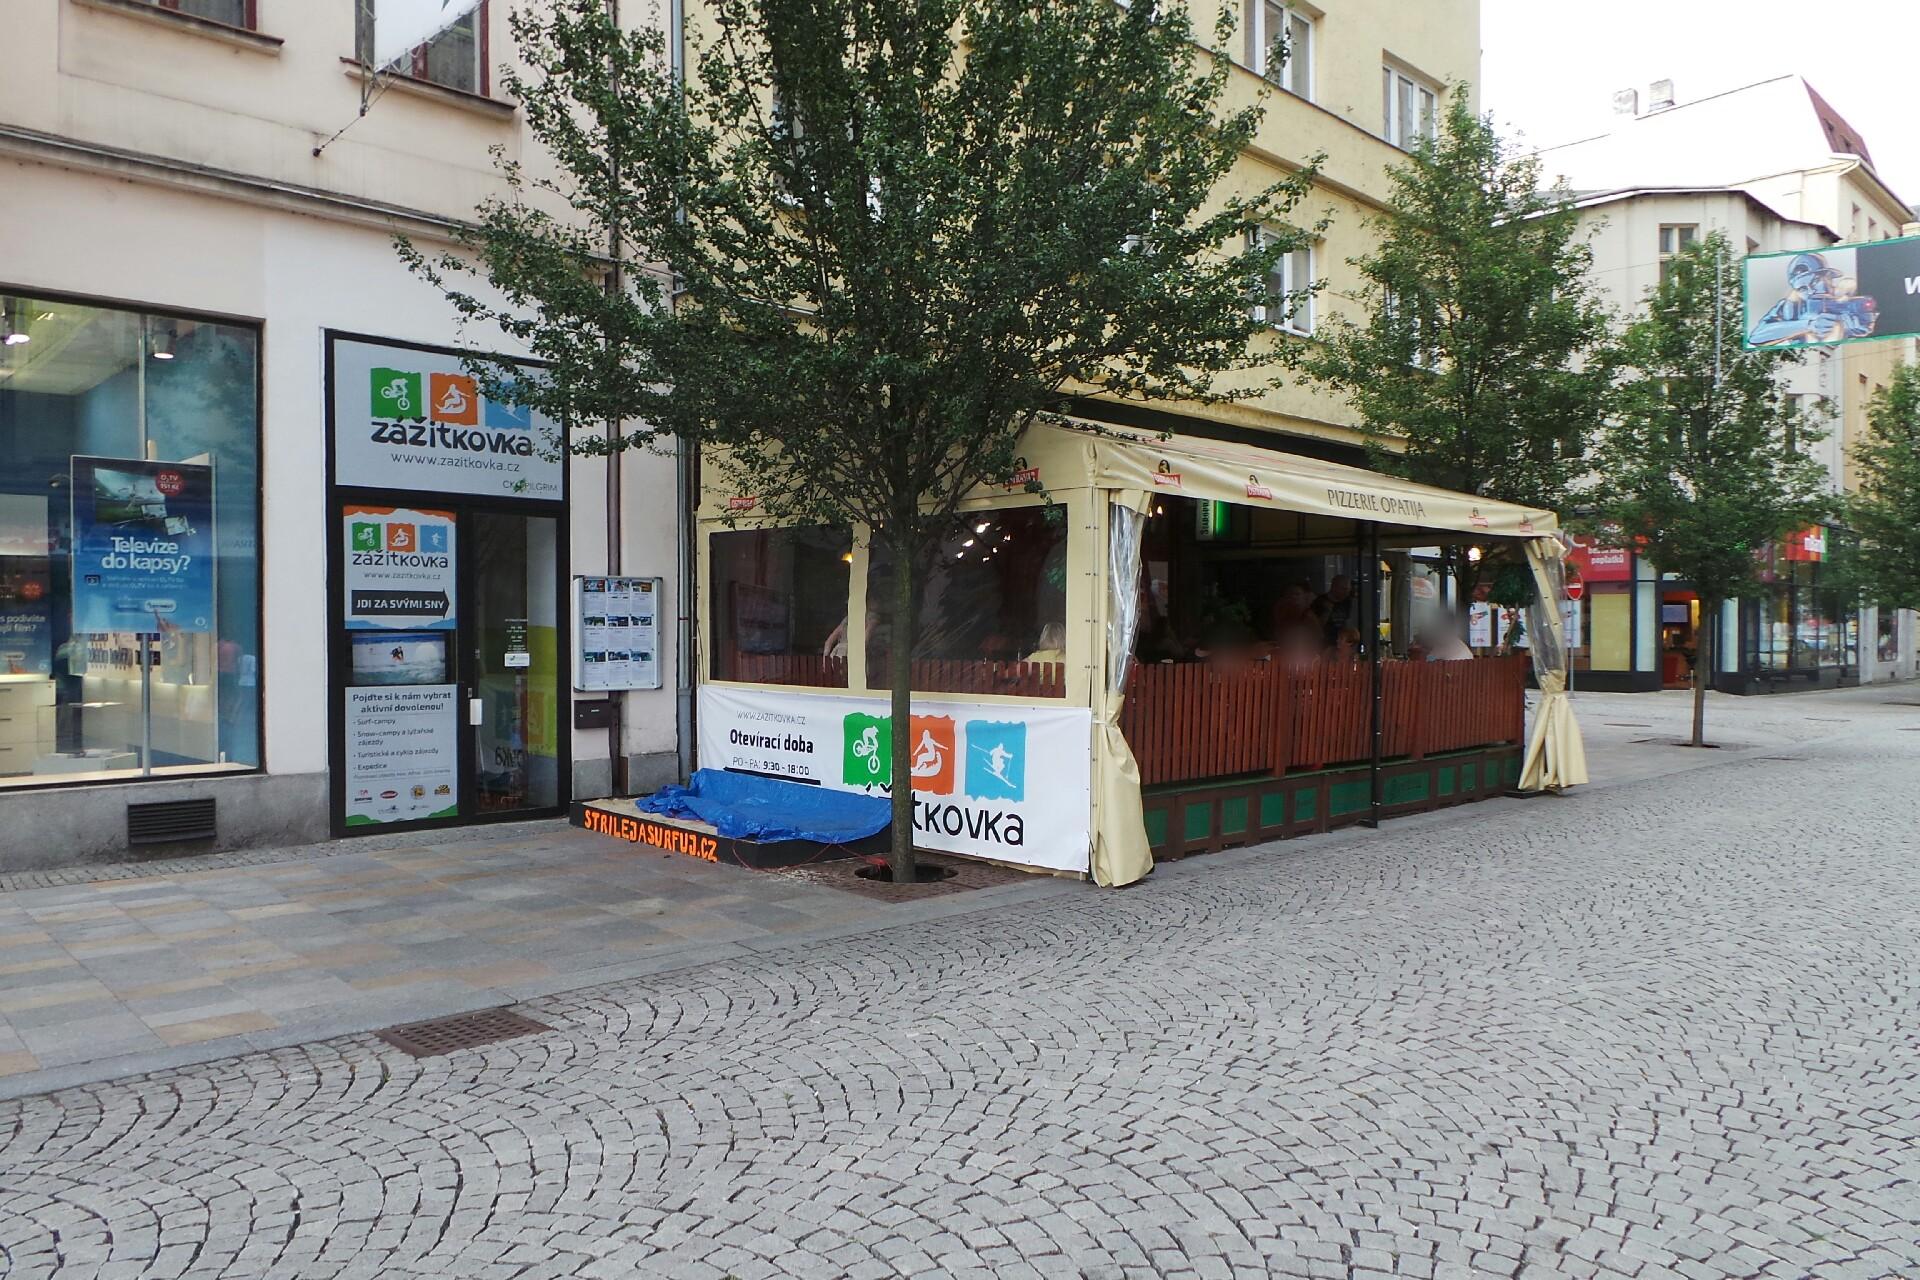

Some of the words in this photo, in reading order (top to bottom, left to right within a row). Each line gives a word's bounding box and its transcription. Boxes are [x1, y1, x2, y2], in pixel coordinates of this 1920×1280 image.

[371, 415, 533, 456] zážitkovka
[1327, 489, 1379, 512] PIZZERIE
[1380, 497, 1426, 520] OPATIJA
[110, 536, 178, 554] Televize
[101, 552, 127, 569] do
[129, 553, 191, 575] kapsy?
[352, 549, 448, 568] zážitkovka
[357, 599, 372, 609] JDI
[374, 600, 388, 609] ZA
[390, 597, 423, 609] SVÝMI
[424, 599, 445, 609] SNY
[353, 694, 383, 702] Pojďte
[385, 693, 393, 701] si
[401, 692, 421, 700] nám
[423, 692, 451, 701] vybrat
[361, 704, 393, 713] aktivní
[394, 703, 444, 712] dovolenou!
[729, 729, 781, 750] Otevírací
[784, 734, 814, 753] doba
[733, 757, 744, 767] PO
[763, 761, 780, 771] 9:30
[787, 764, 810, 775] 18:00
[584, 809, 718, 863] STRILEJASURFUJ.CZ
